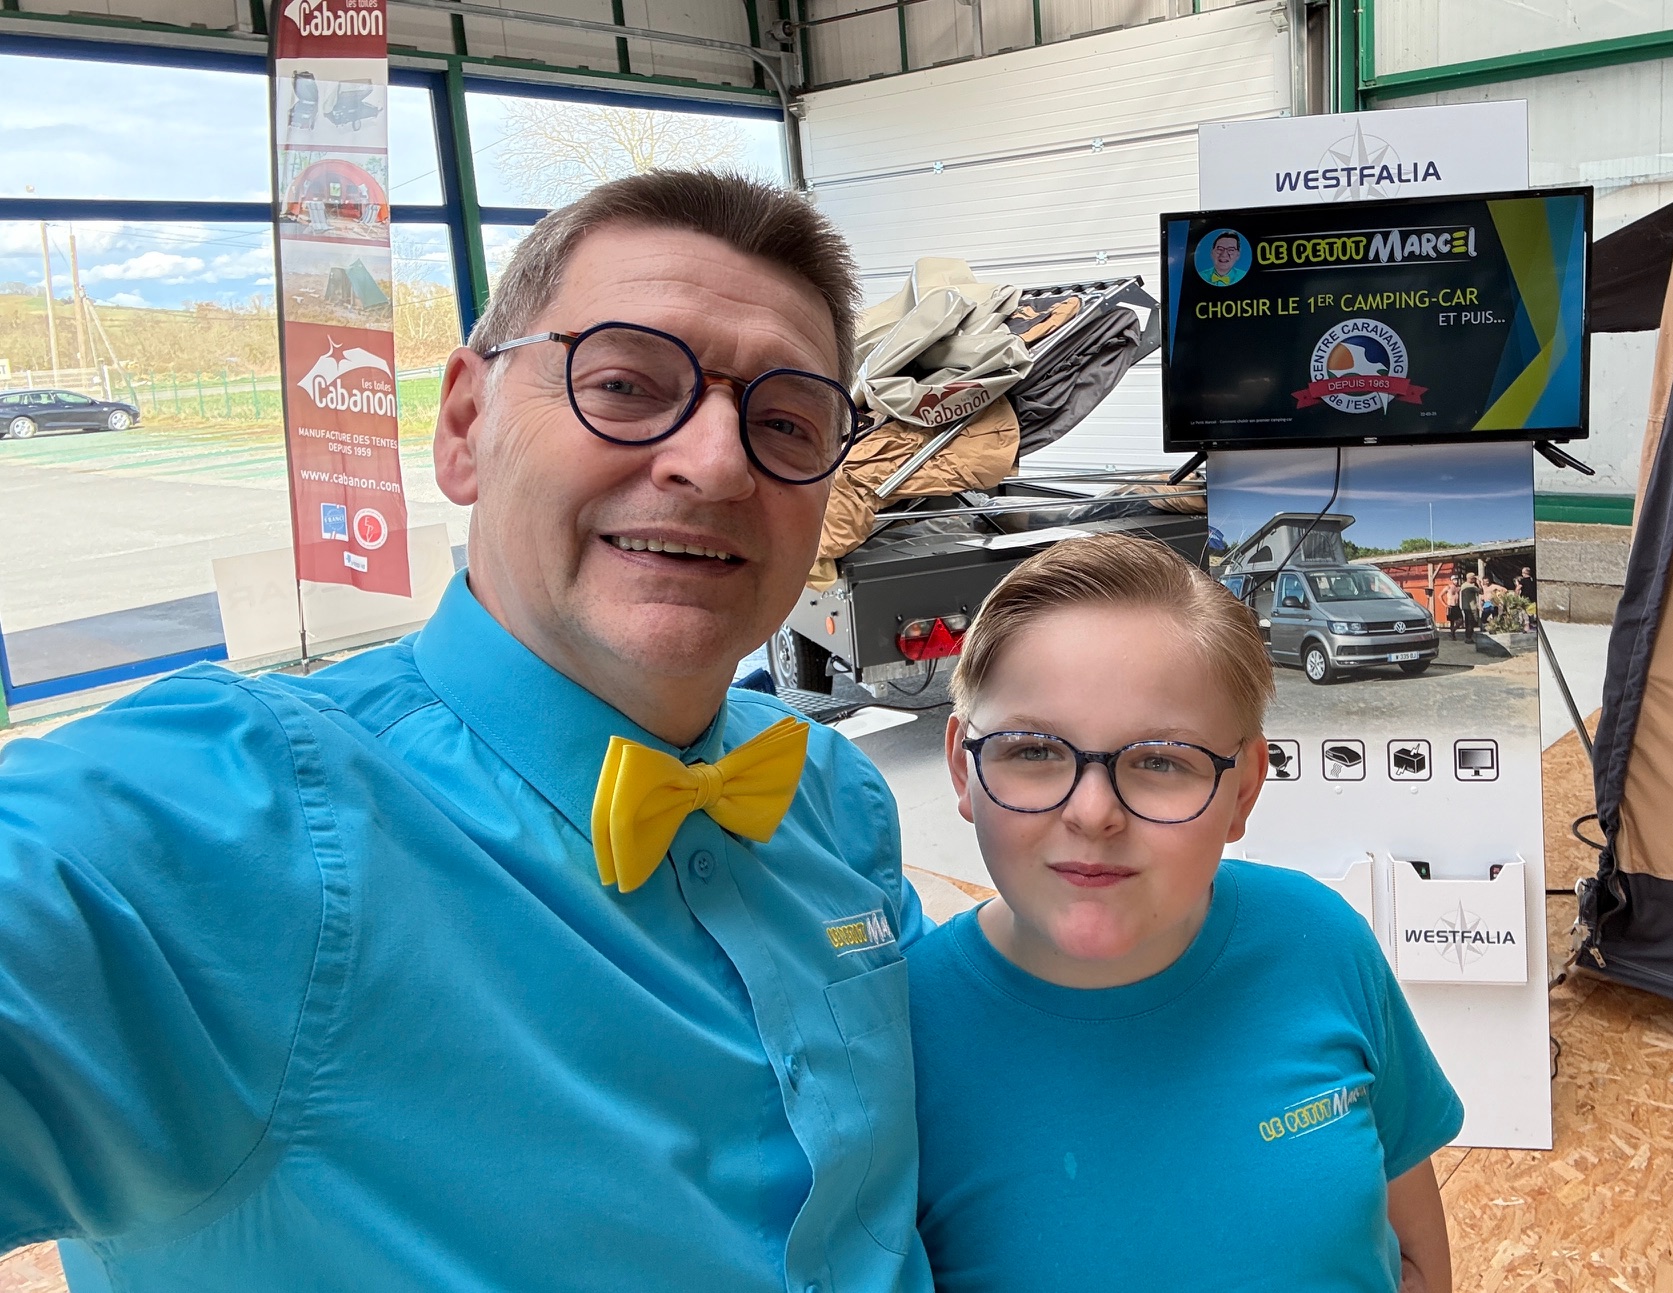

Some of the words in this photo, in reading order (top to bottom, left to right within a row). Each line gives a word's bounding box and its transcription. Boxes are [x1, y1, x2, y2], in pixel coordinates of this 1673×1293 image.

[300, 2, 383, 36] Cabanon
[1275, 160, 1442, 193] WESTFALIA
[1256, 242, 1288, 265] LE
[1292, 235, 1367, 264] PETIT
[1195, 299, 1272, 320] CHOISIR
[1277, 297, 1300, 316] LE
[1306, 293, 1335, 314] 1ER
[1340, 288, 1479, 312] CAMPING-CAR
[1438, 313, 1459, 326] ET
[1462, 310, 1506, 325] PUIS...
[1313, 330, 1340, 382] CENTRE
[1341, 321, 1404, 374] CARAVANING
[312, 374, 396, 418] Cabanon
[361, 378, 373, 389] les
[374, 379, 392, 393] toiles
[1328, 379, 1366, 391] DEPUIS
[1368, 379, 1390, 389] 1963
[920, 390, 990, 426] Cabanon
[1329, 394, 1343, 407] de
[298, 427, 351, 444] MANUFACTURE
[353, 434, 370, 446] DES
[370, 437, 398, 450] TENTES
[328, 442, 353, 456] DEPUIS
[354, 446, 372, 458] 1959
[300, 469, 401, 494] www.cabanon.com
[1405, 929, 1516, 945] WESTFALIA
[1259, 1117, 1286, 1142] LE
[1284, 1098, 1332, 1133] PETIT
